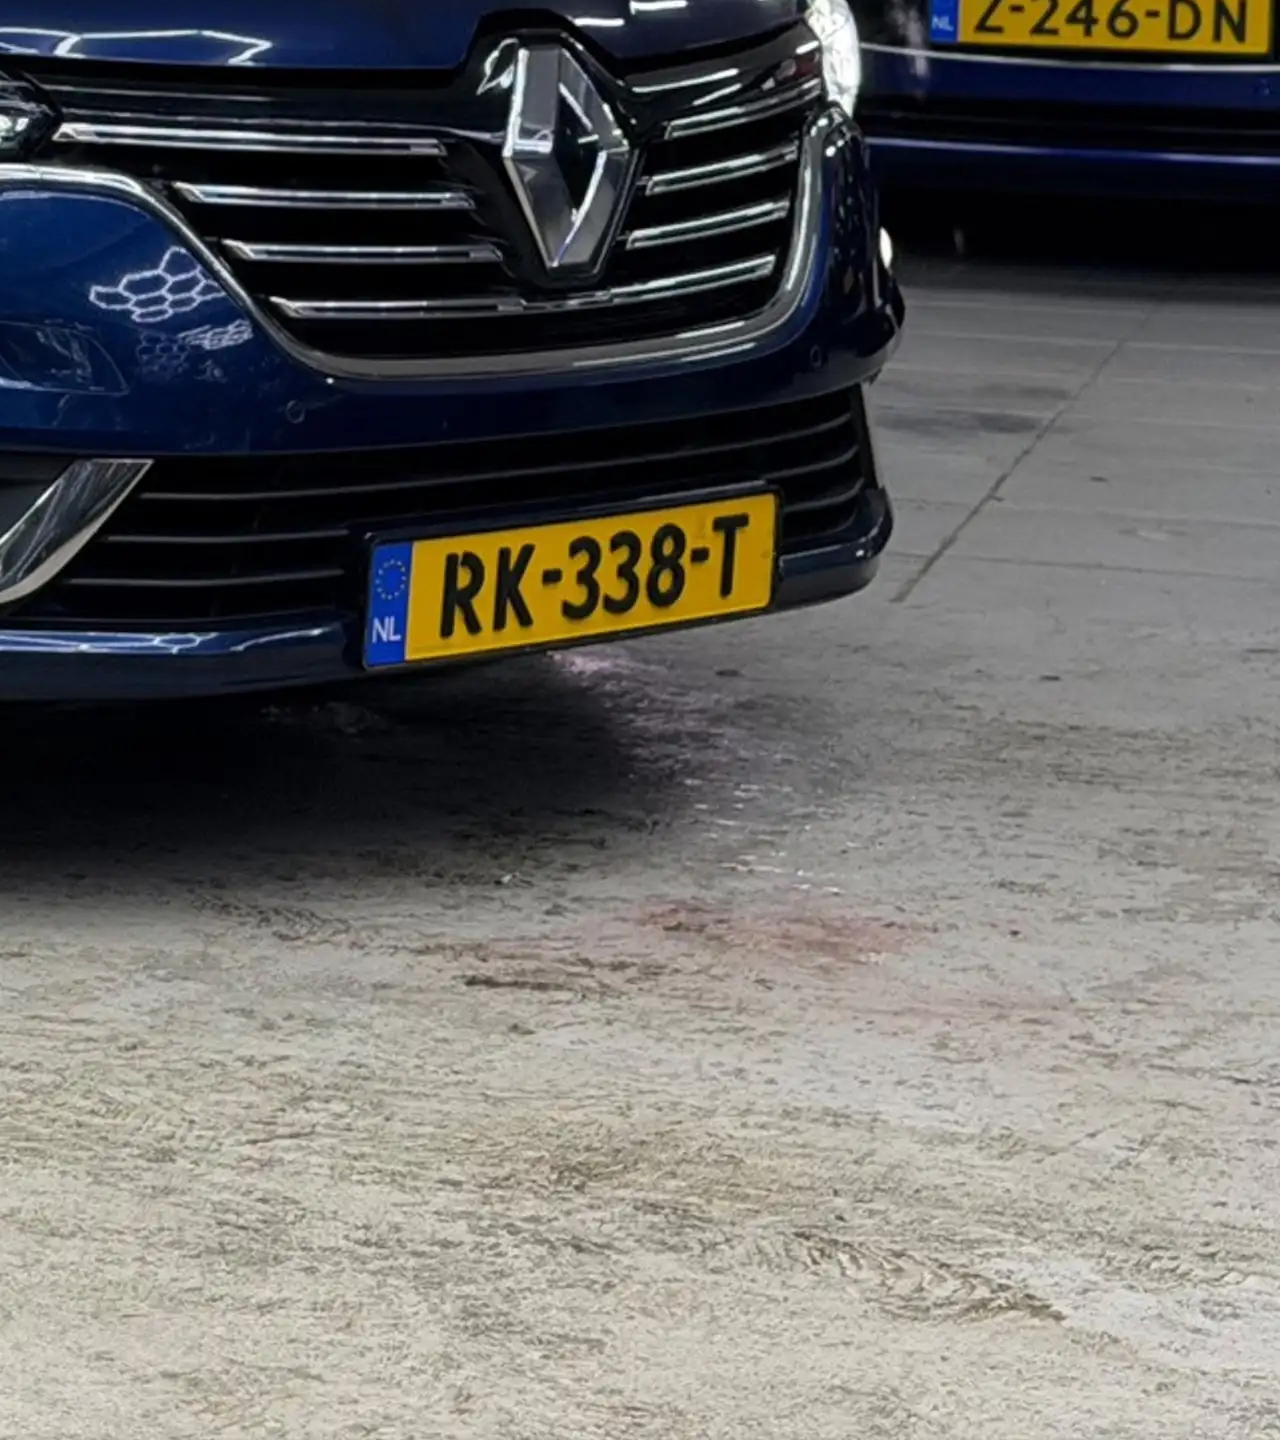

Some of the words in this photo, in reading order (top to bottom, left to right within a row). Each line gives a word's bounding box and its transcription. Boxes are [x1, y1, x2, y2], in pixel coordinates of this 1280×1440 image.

[931, 15, 954, 31] NL
[440, 512, 750, 639] RK-338-T
[371, 615, 402, 643] NL
